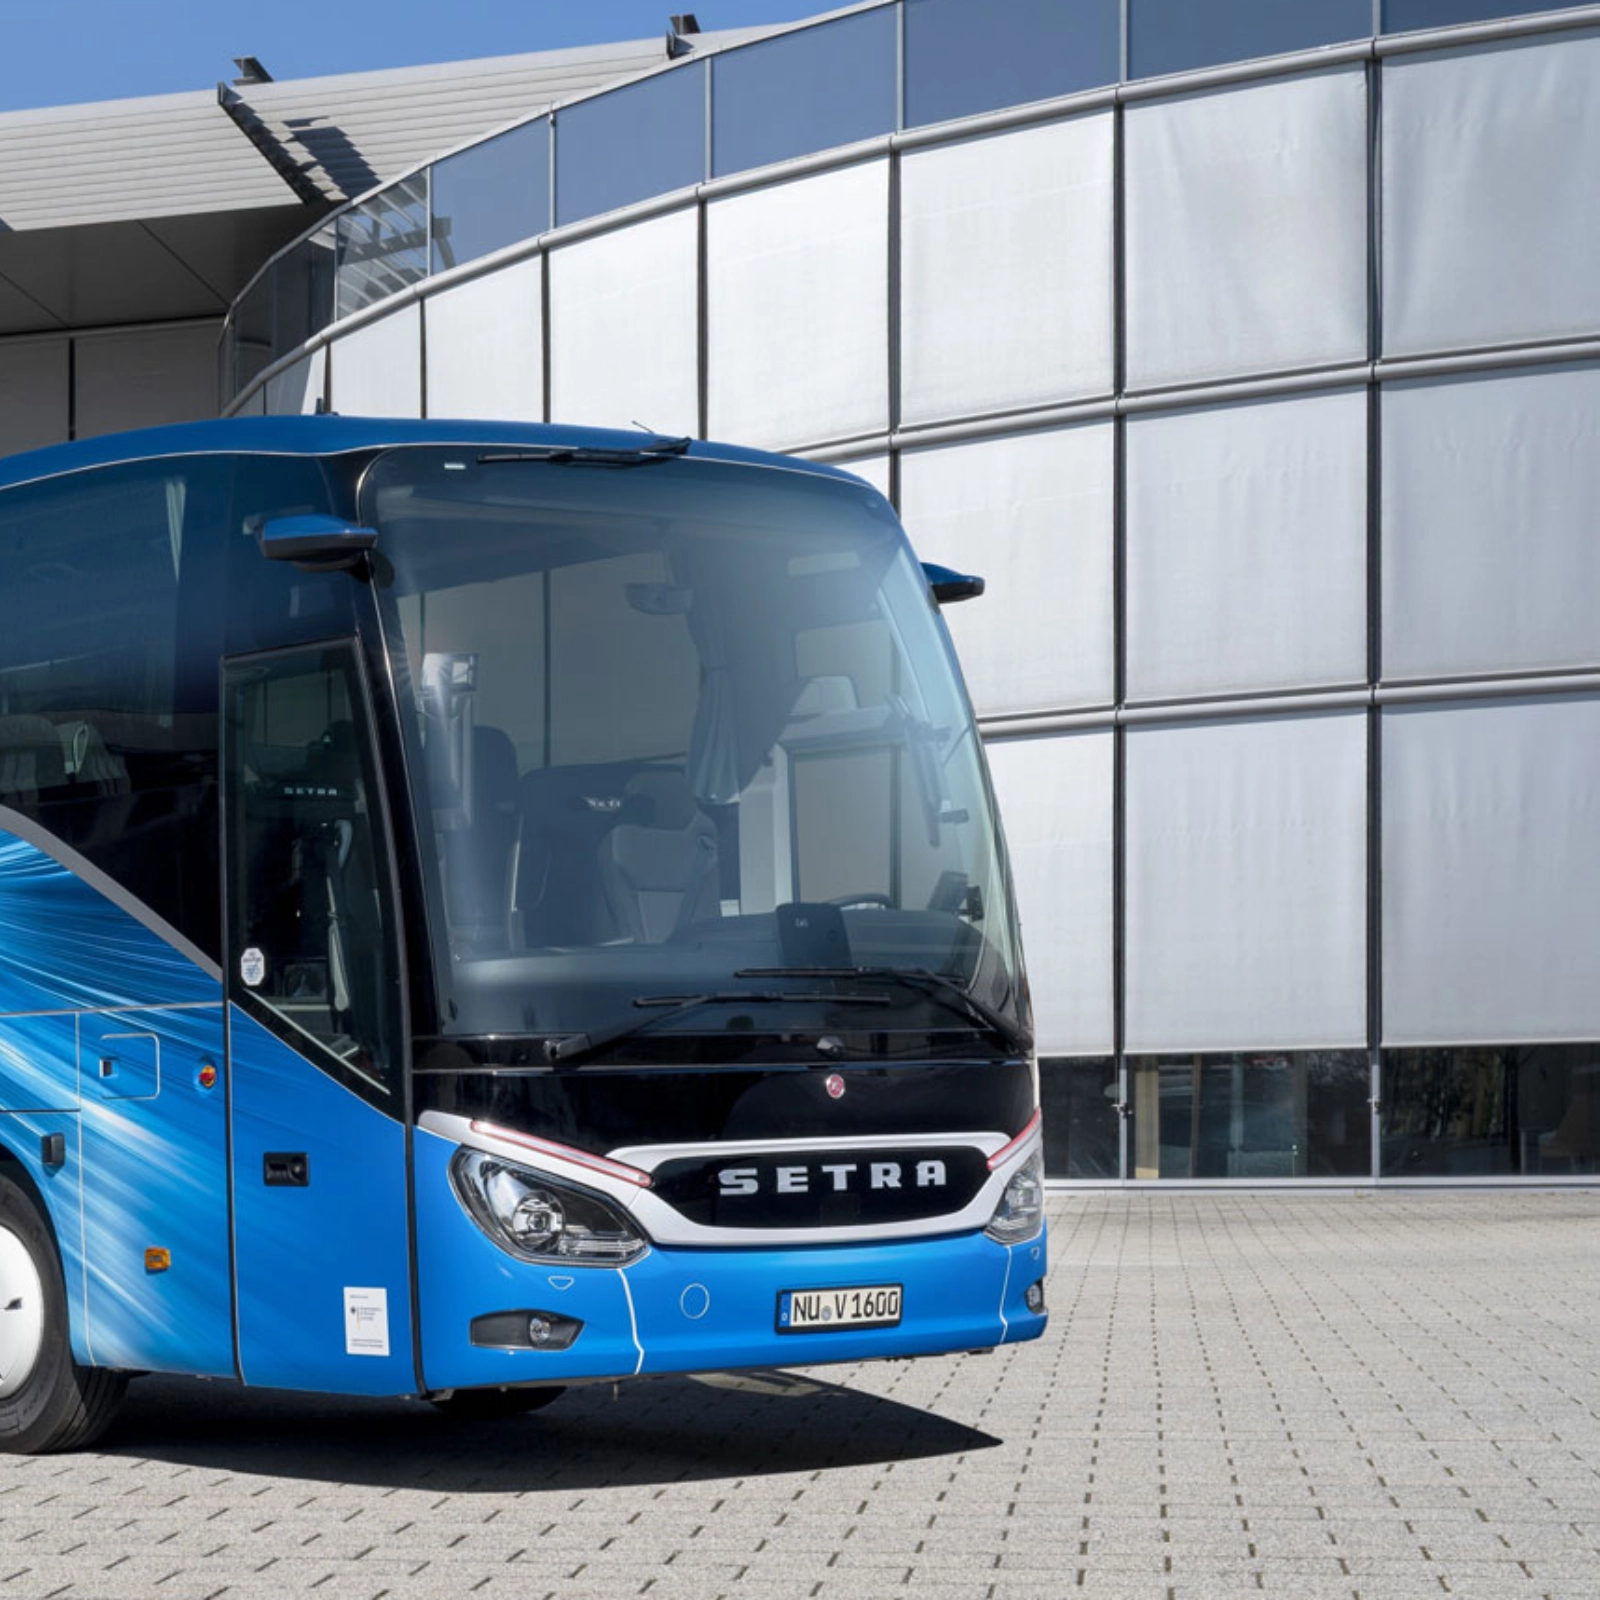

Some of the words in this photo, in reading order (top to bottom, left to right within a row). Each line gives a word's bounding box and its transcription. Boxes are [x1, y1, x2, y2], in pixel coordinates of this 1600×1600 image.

[718, 1160, 947, 1196] SETRA
[793, 1294, 820, 1322] NU
[834, 1293, 847, 1319] V
[850, 1290, 899, 1319] 1600
